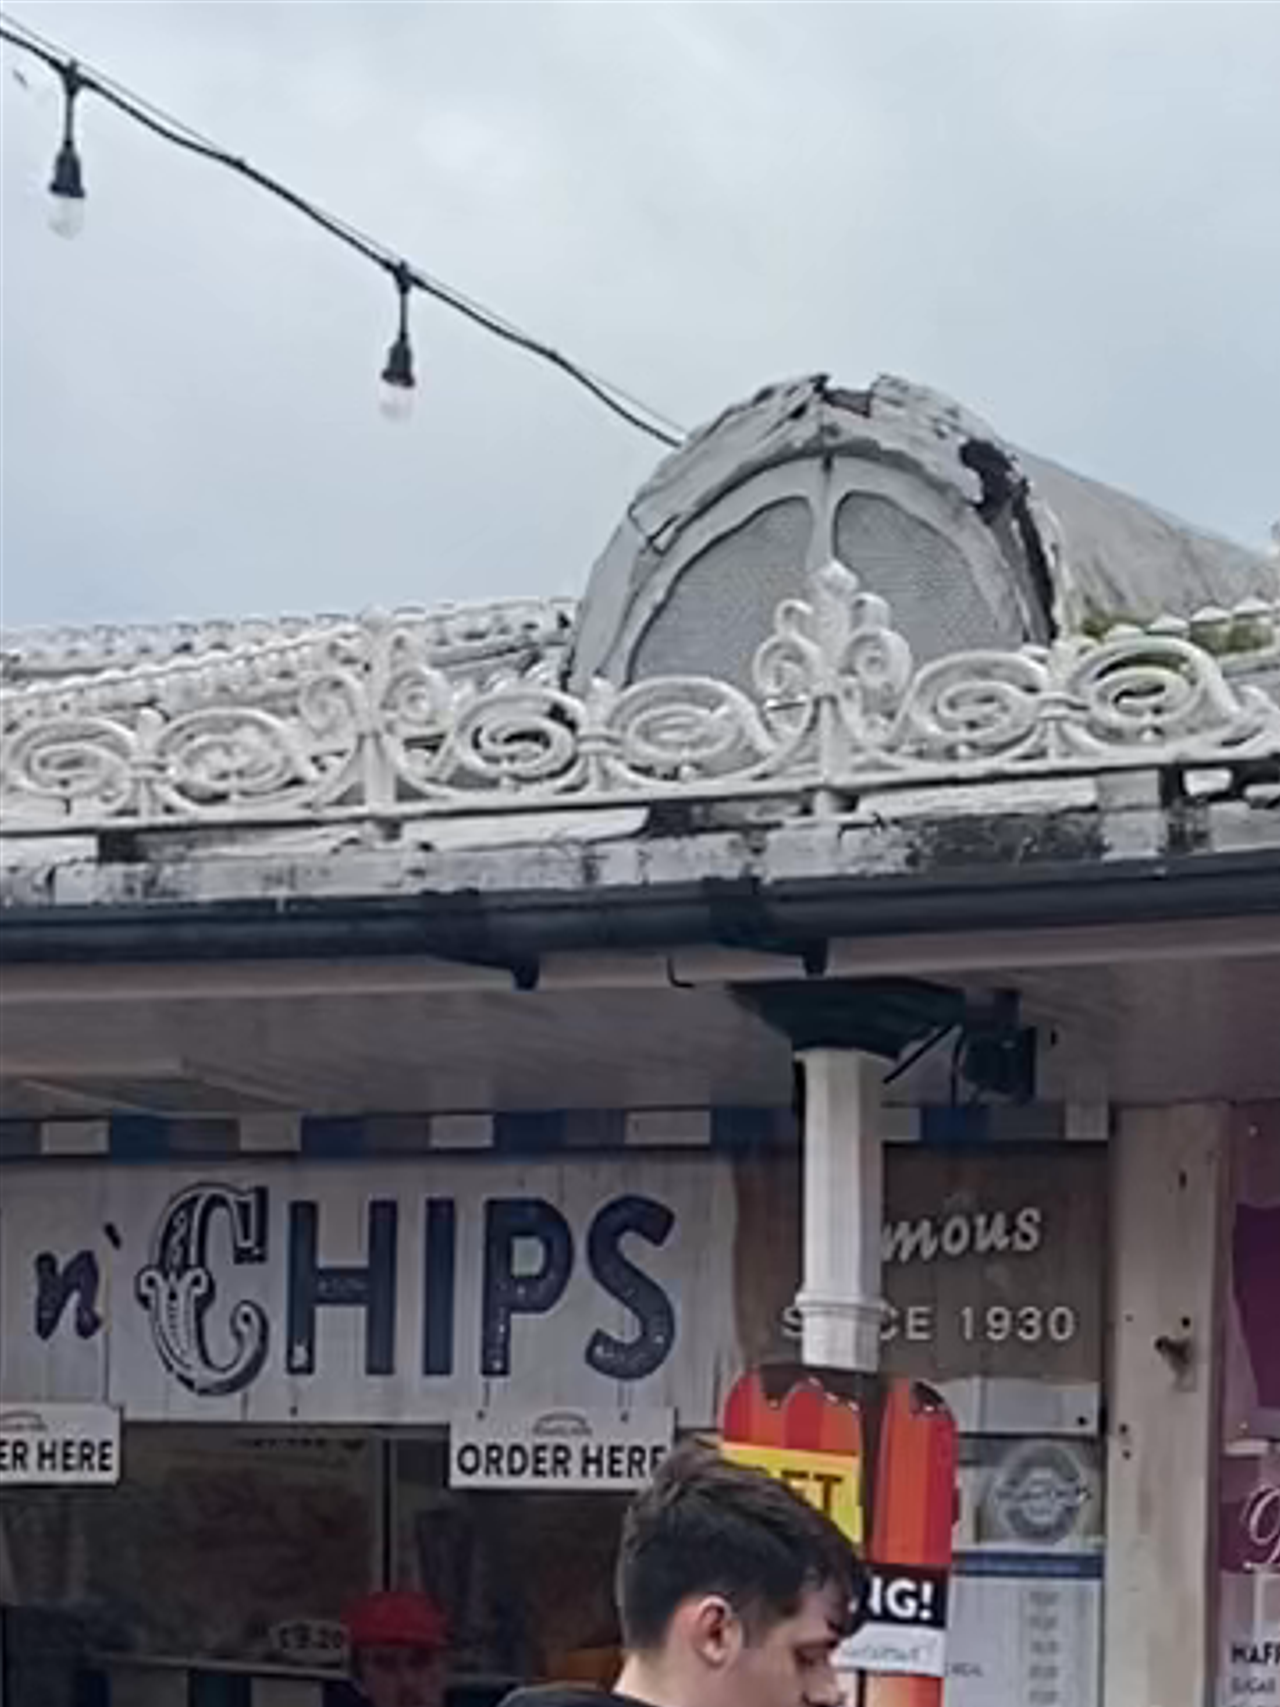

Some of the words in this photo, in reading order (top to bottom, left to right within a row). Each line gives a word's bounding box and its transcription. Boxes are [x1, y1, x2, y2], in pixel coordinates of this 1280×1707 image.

[882, 1207, 1042, 1262] mous
[136, 1180, 676, 1396] CHIPS
[782, 1305, 933, 1342] SCE
[961, 1305, 1077, 1342] 1930
[37, 1439, 113, 1474] HERE
[457, 1443, 573, 1478] ORDER
